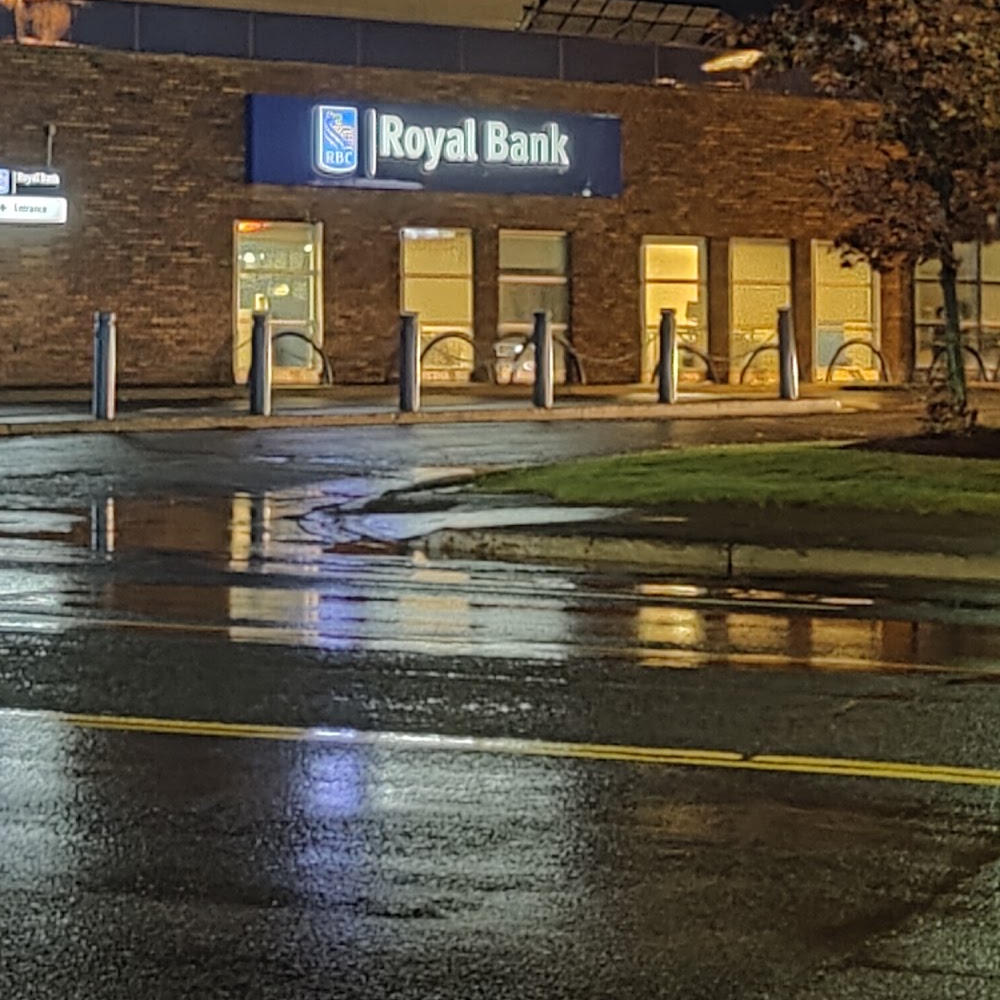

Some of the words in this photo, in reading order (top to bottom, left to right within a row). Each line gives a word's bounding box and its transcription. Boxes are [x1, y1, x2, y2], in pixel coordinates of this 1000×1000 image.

[325, 150, 354, 165] RBC
[379, 113, 478, 172] Royal
[481, 120, 570, 168] Bank
